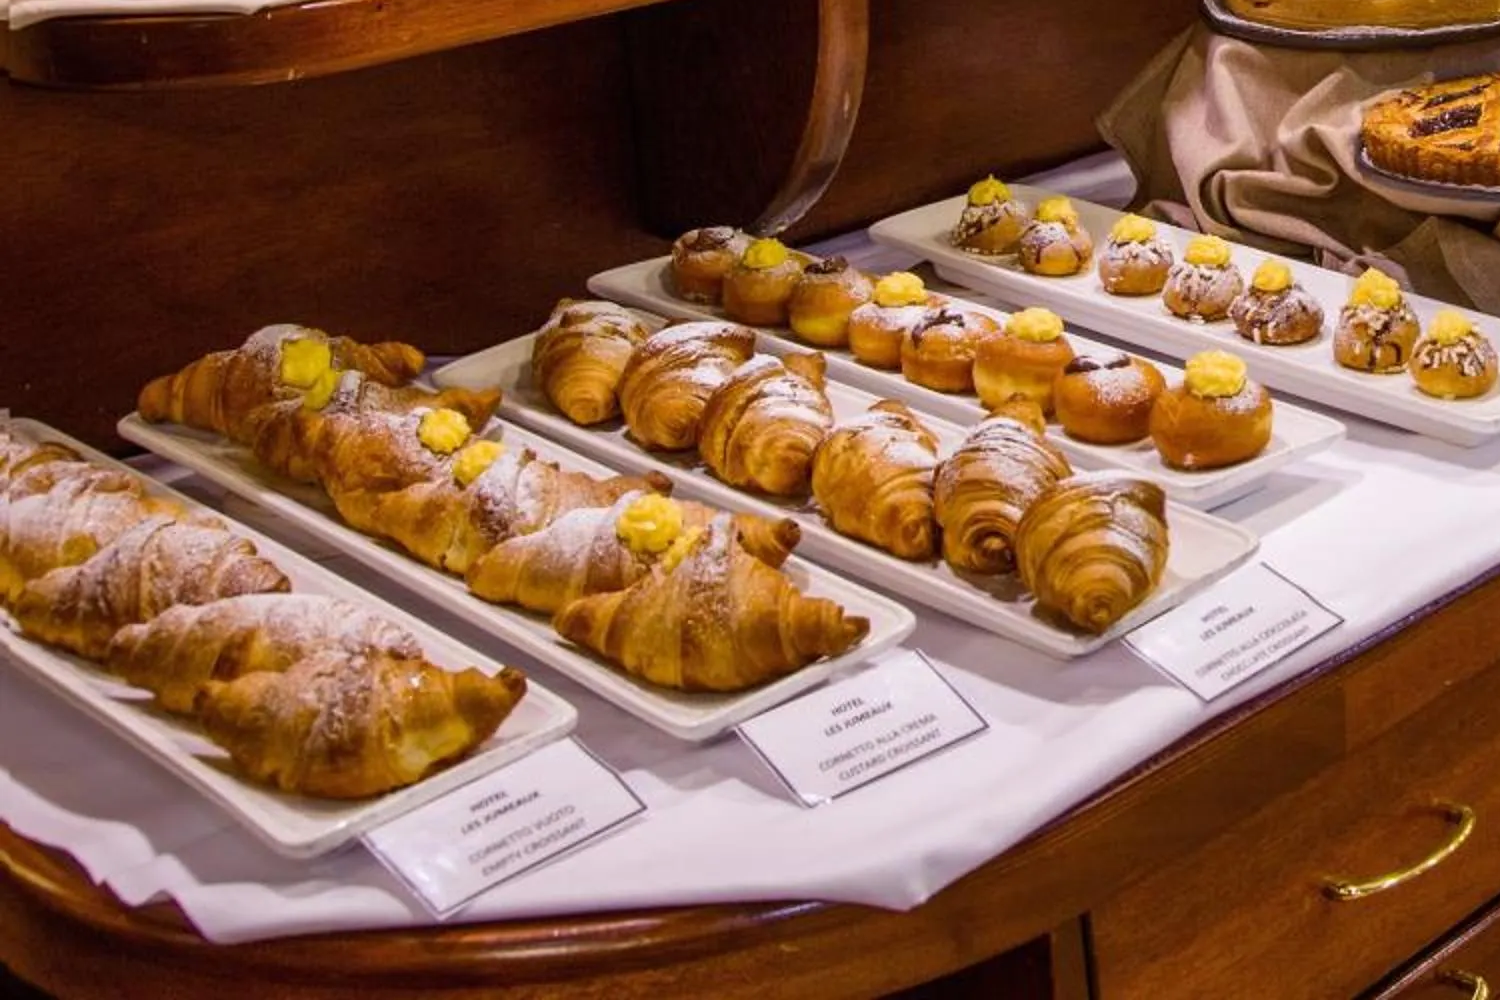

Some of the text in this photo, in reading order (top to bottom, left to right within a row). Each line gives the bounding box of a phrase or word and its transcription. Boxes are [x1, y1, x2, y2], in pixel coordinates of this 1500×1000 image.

[824, 723, 844, 737] LES
[830, 697, 865, 717] HOTEL
[818, 740, 876, 772] CORNETTO
[876, 730, 900, 744] ALLA
[838, 727, 941, 781] CUSTARD CROISSANT
[468, 804, 575, 864] CORNETTO VUOTO
[481, 817, 585, 876] EMPTY CROISSANT
